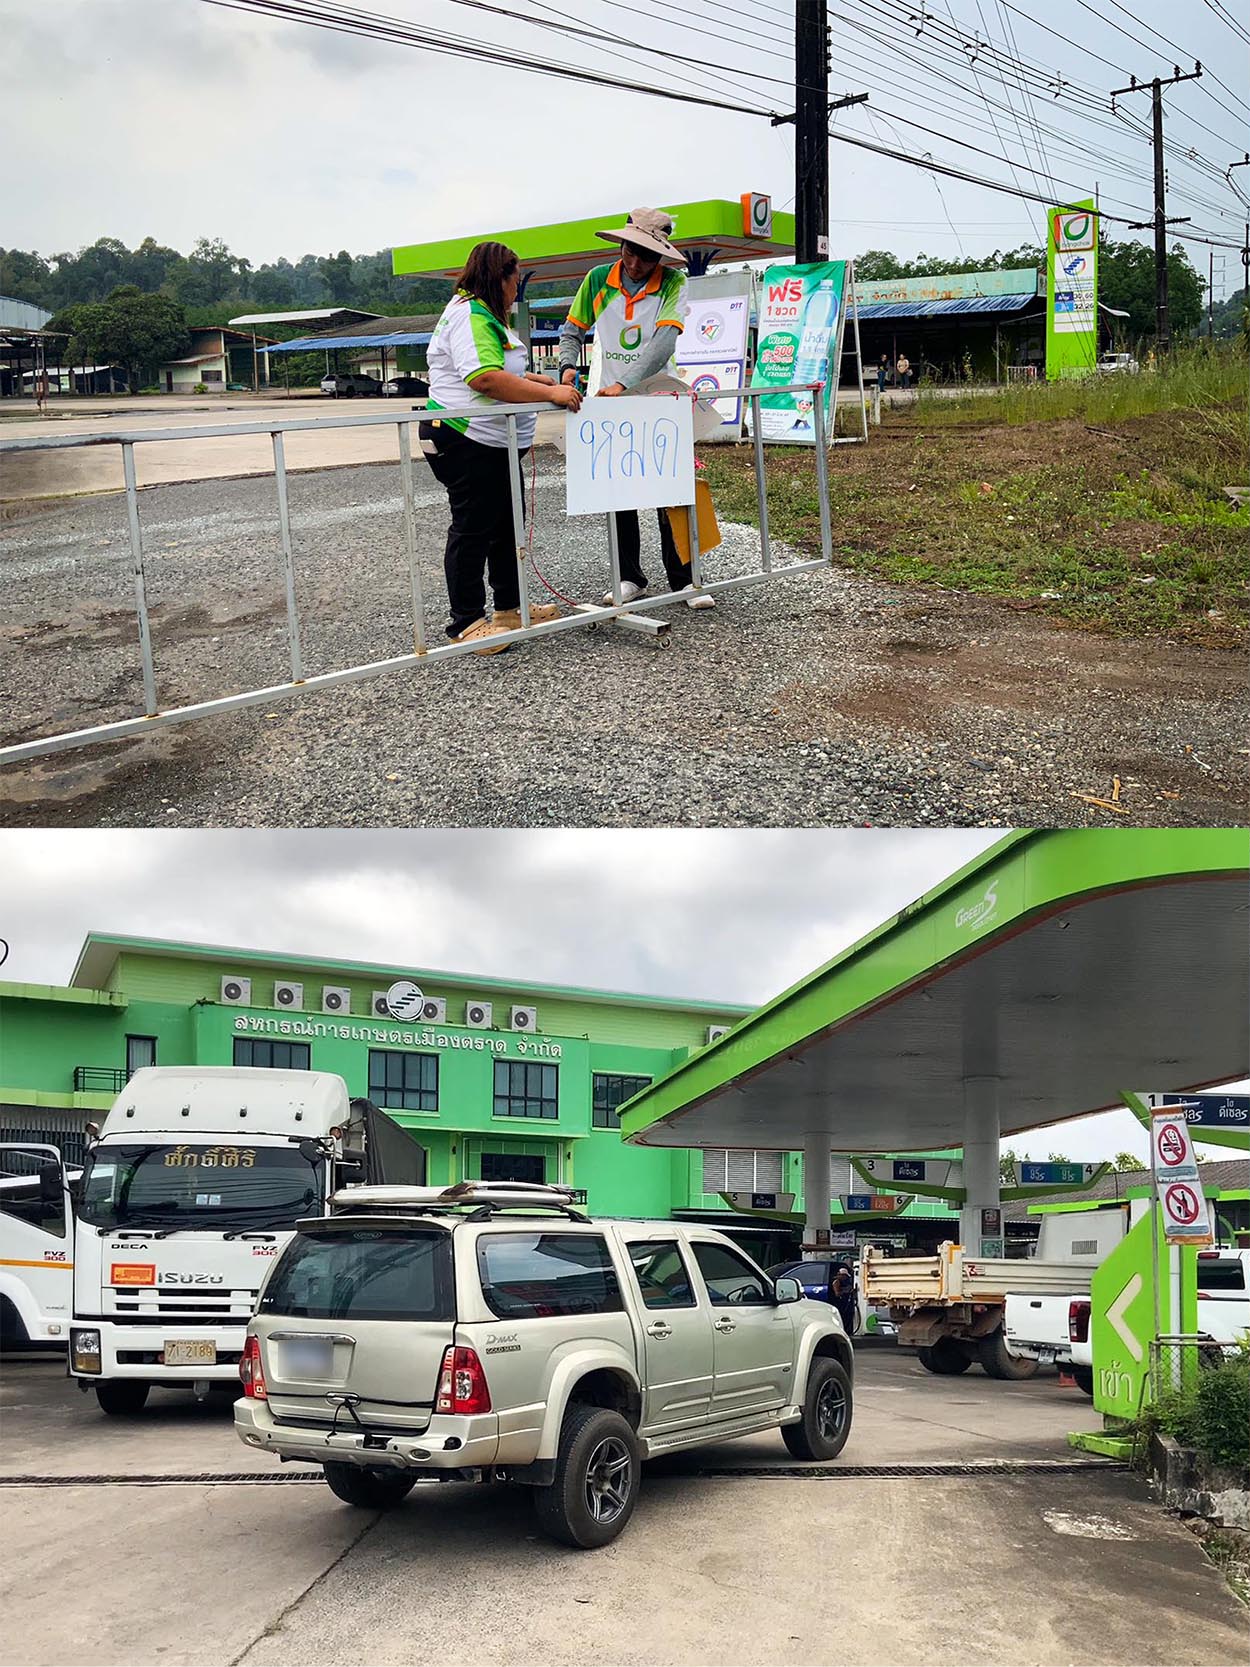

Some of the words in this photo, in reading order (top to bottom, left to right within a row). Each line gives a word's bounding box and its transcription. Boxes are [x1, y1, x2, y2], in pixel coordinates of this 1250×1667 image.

[768, 278, 803, 303] ฟรี
[775, 306, 798, 316] ขวด
[774, 345, 794, 356] 500
[605, 350, 641, 365] bangc
[579, 417, 679, 481] หมด
[233, 1014, 507, 1054] สหกรณ์การเกษตรเมืองตราด
[516, 1037, 563, 1058] จำกัด
[1148, 1094, 1156, 1107] 1
[867, 1160, 875, 1171] 3
[1085, 1164, 1093, 1175] 4
[732, 1193, 738, 1202] 5
[896, 1195, 903, 1205] 6
[158, 1272, 224, 1284] ISUZU
[1099, 1359, 1133, 1403] เข้า
